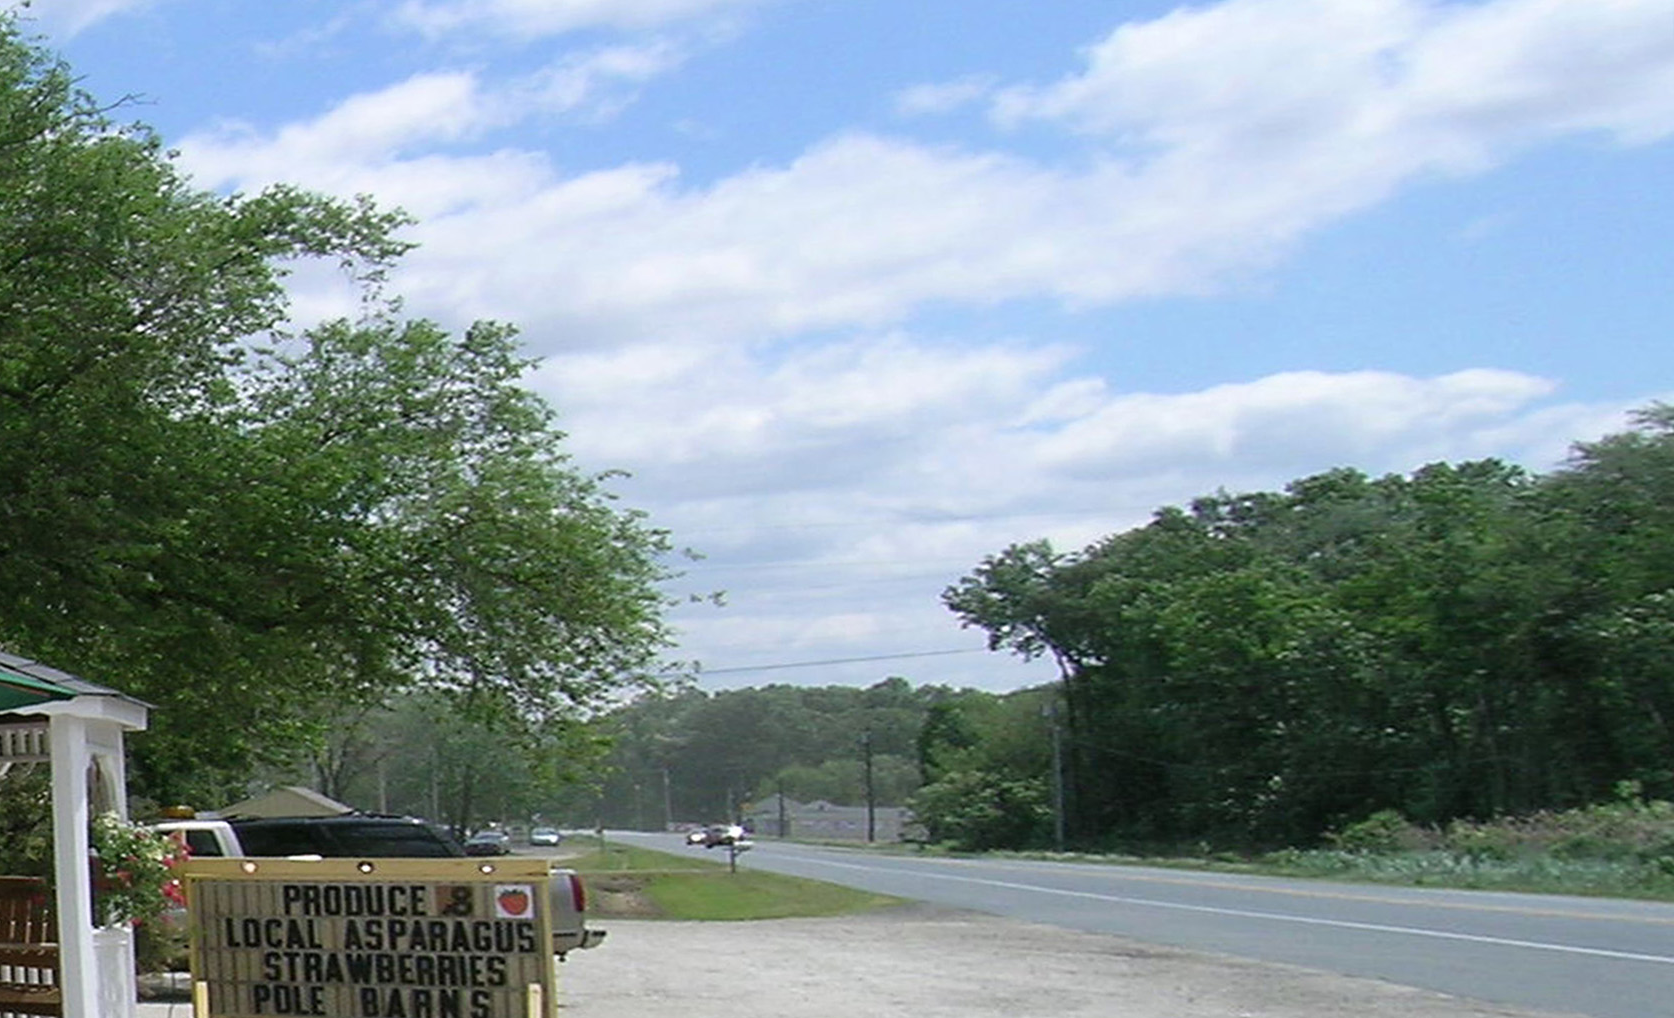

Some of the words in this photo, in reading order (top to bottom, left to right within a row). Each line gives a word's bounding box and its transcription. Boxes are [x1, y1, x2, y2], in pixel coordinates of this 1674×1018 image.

[283, 884, 427, 917] PRODUCE
[225, 917, 324, 949] LOCAL
[344, 918, 536, 953] ASPARAGUS
[263, 951, 507, 987] STRAWBERRIES
[252, 984, 326, 1016] POLE
